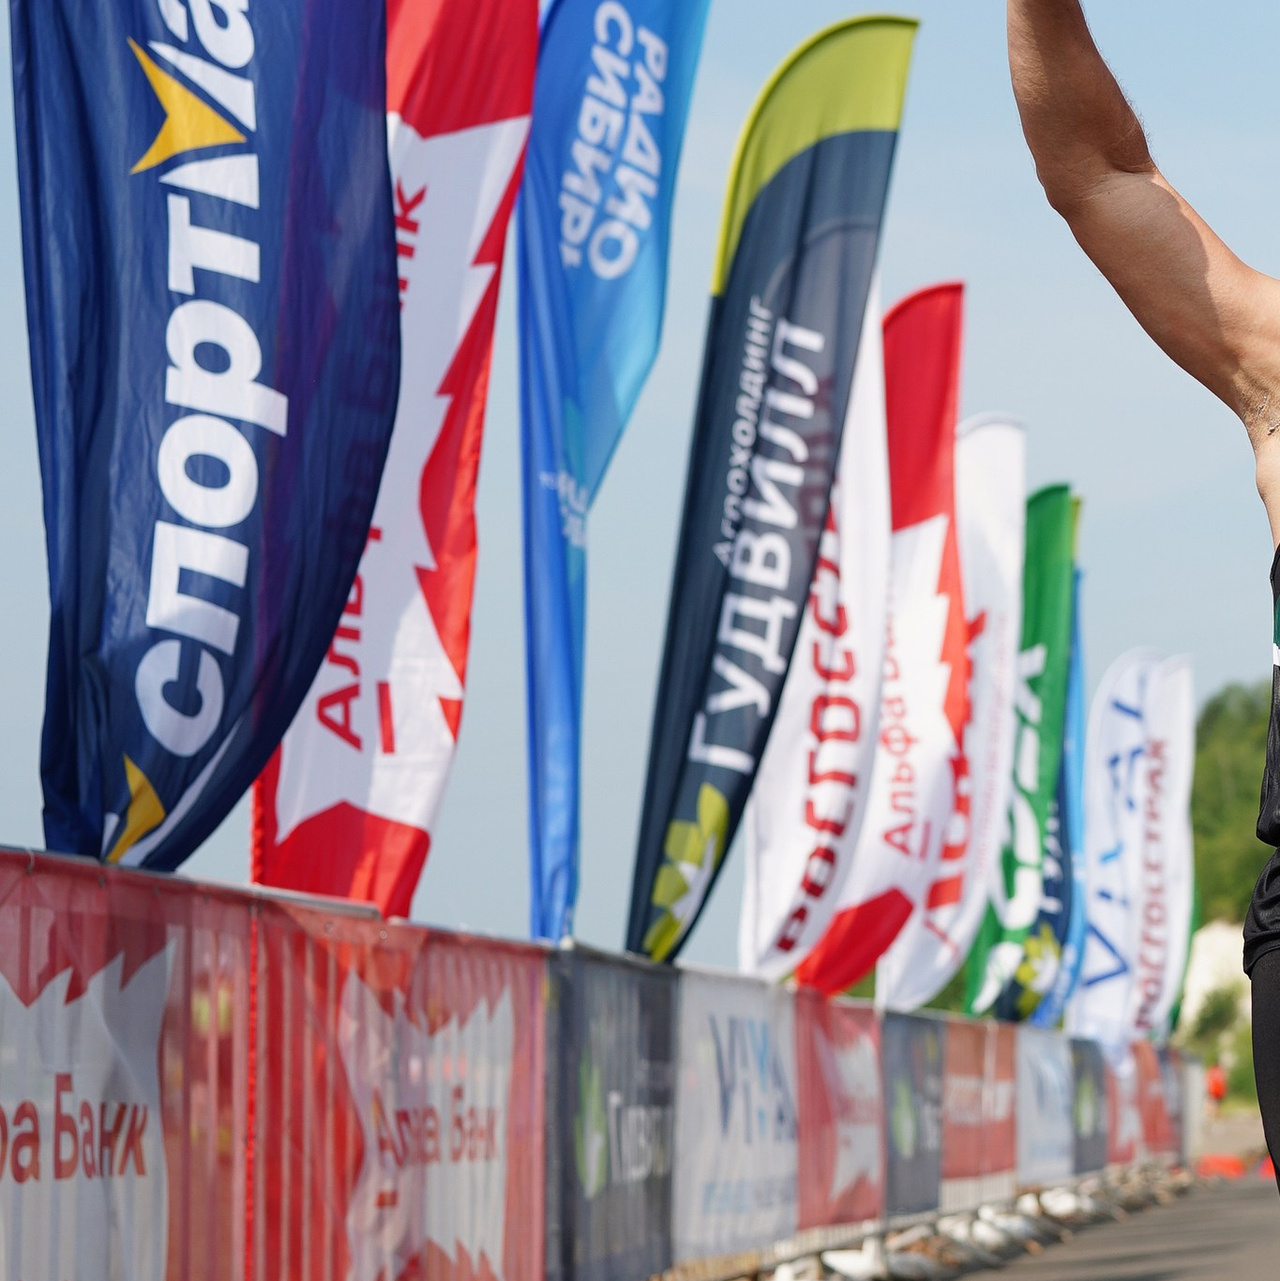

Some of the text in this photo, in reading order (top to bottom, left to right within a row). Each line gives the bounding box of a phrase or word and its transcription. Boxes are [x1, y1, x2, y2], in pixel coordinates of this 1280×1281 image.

[558, 0, 634, 269] СИБИРЬ
[588, 25, 668, 281] РАДИО
[54, 1072, 148, 1180] Банк
